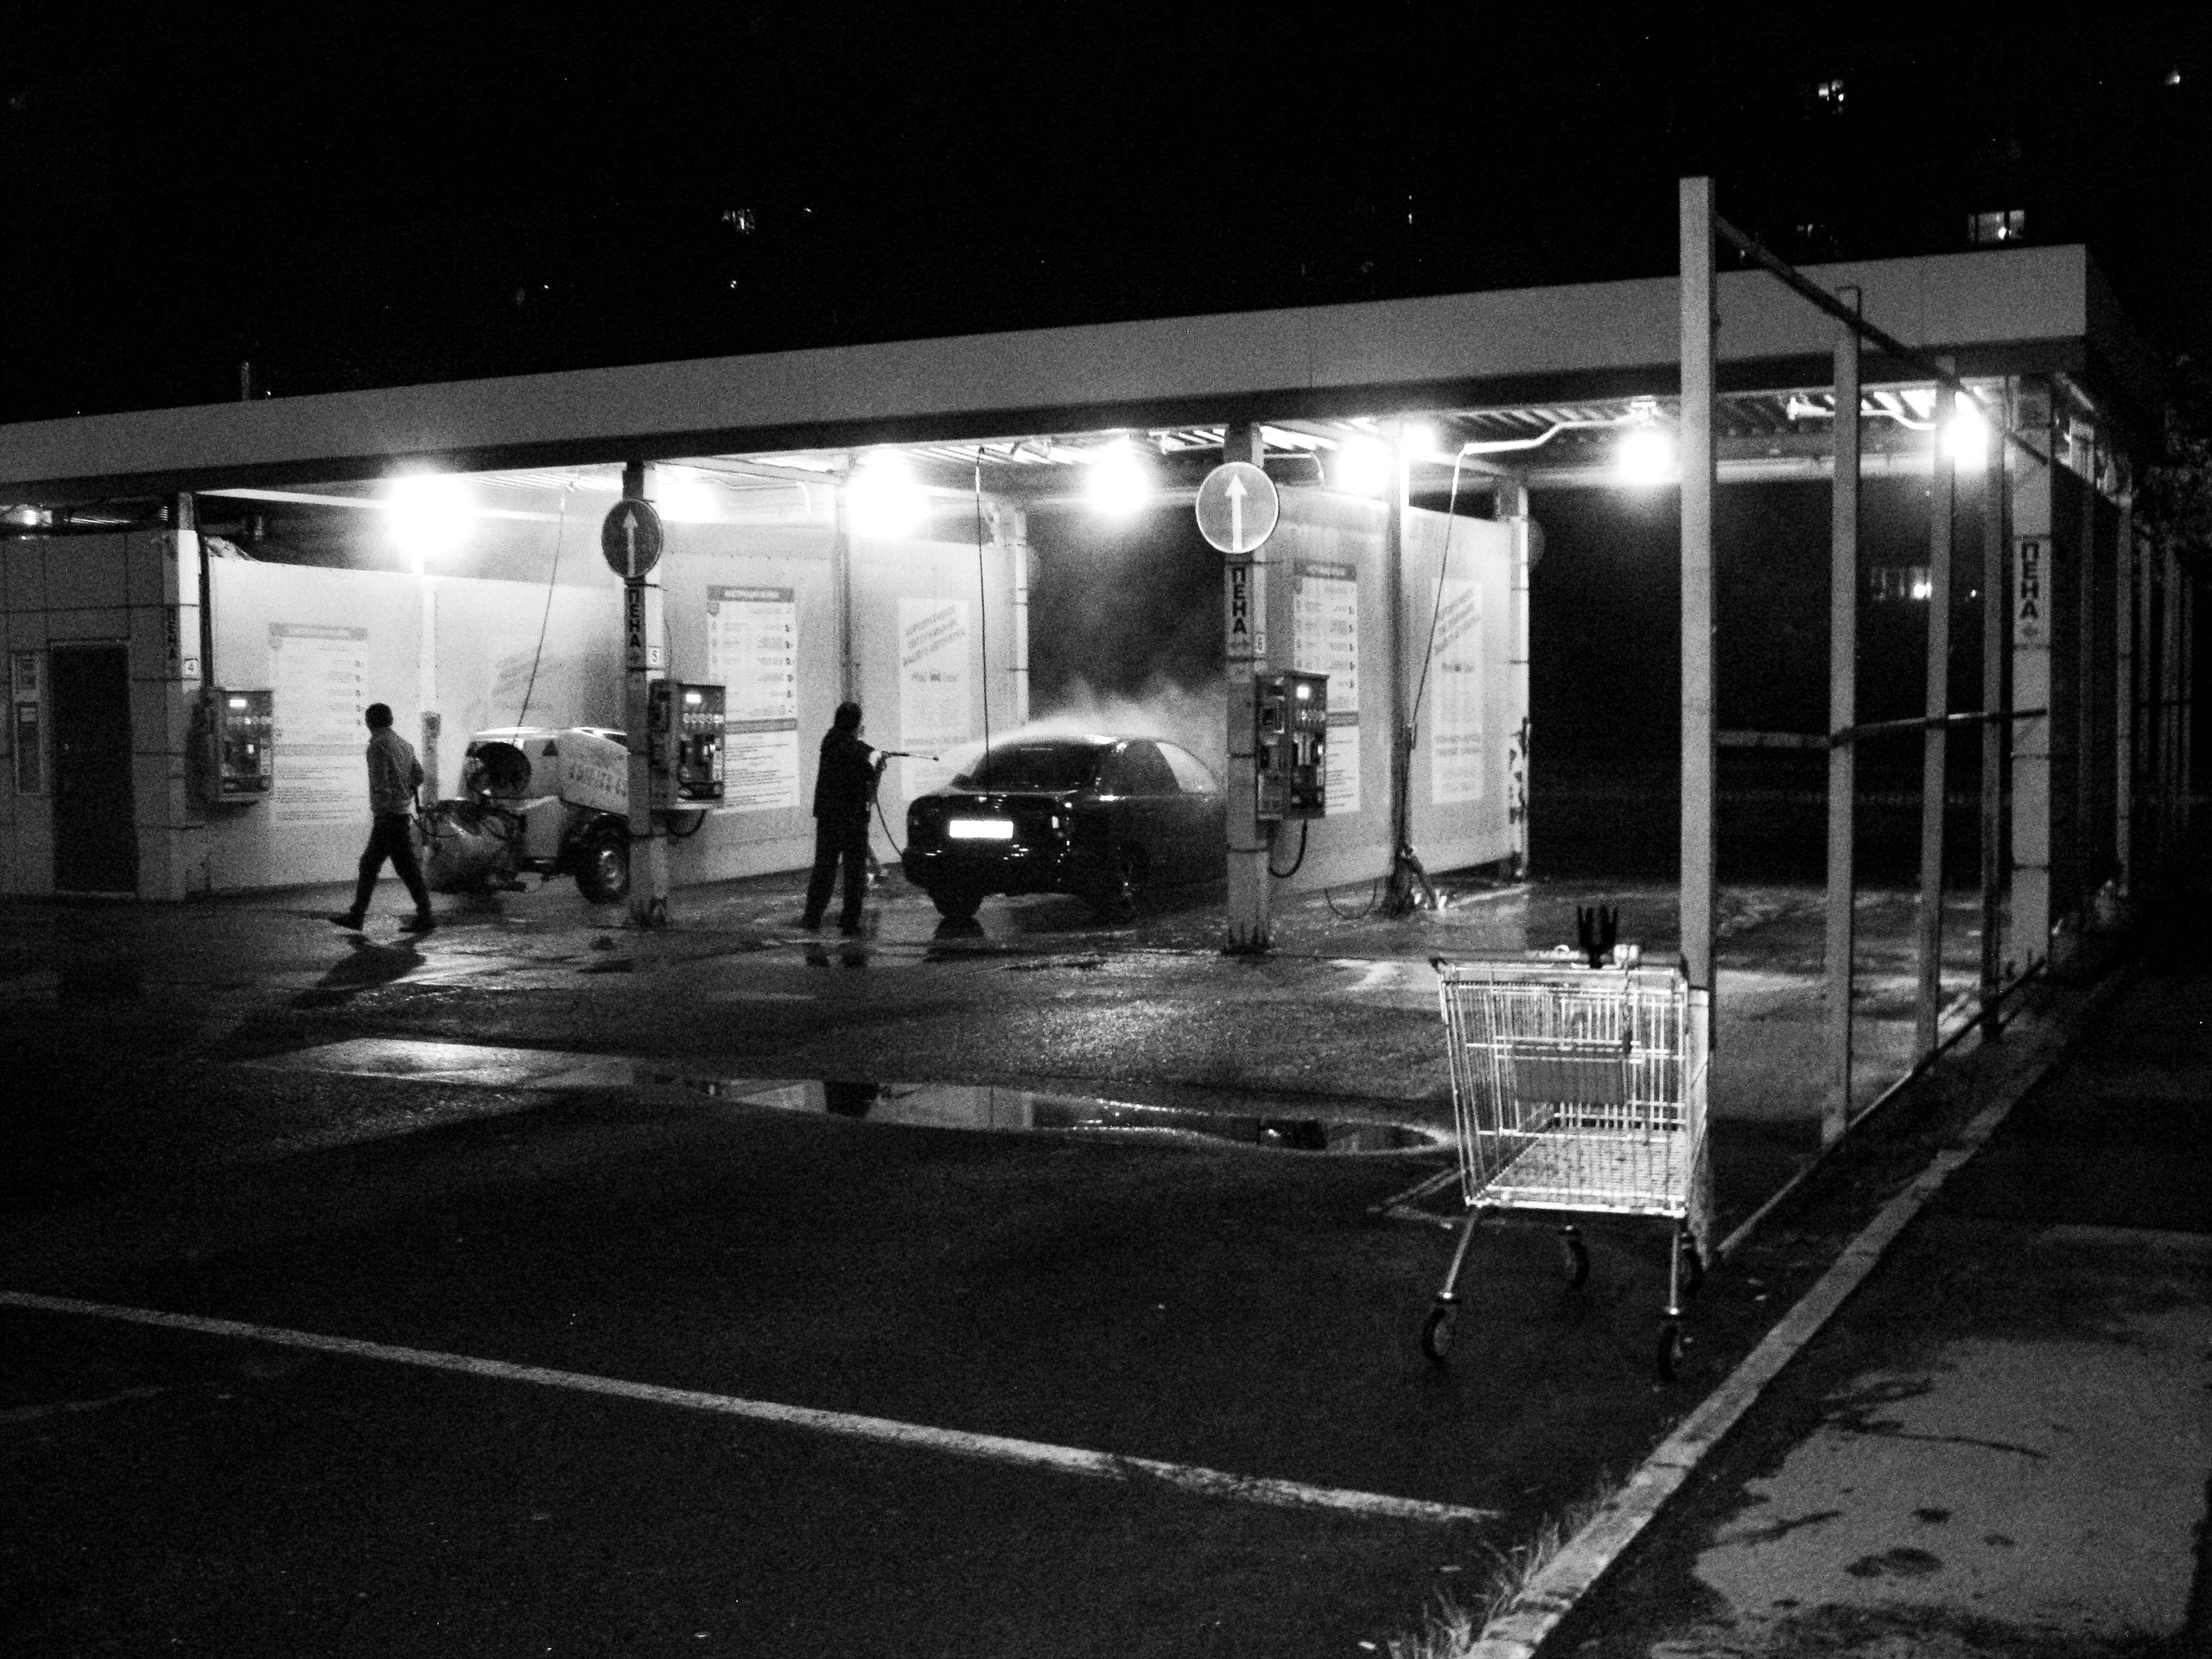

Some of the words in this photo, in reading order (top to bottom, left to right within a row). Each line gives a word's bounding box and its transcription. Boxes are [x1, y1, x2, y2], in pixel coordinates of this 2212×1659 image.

[1232, 567, 1247, 633] ПЕНА
[2020, 543, 2039, 620] ПЕНА
[167, 607, 177, 660] ПЕНА
[628, 588, 640, 647] ПЕНА
